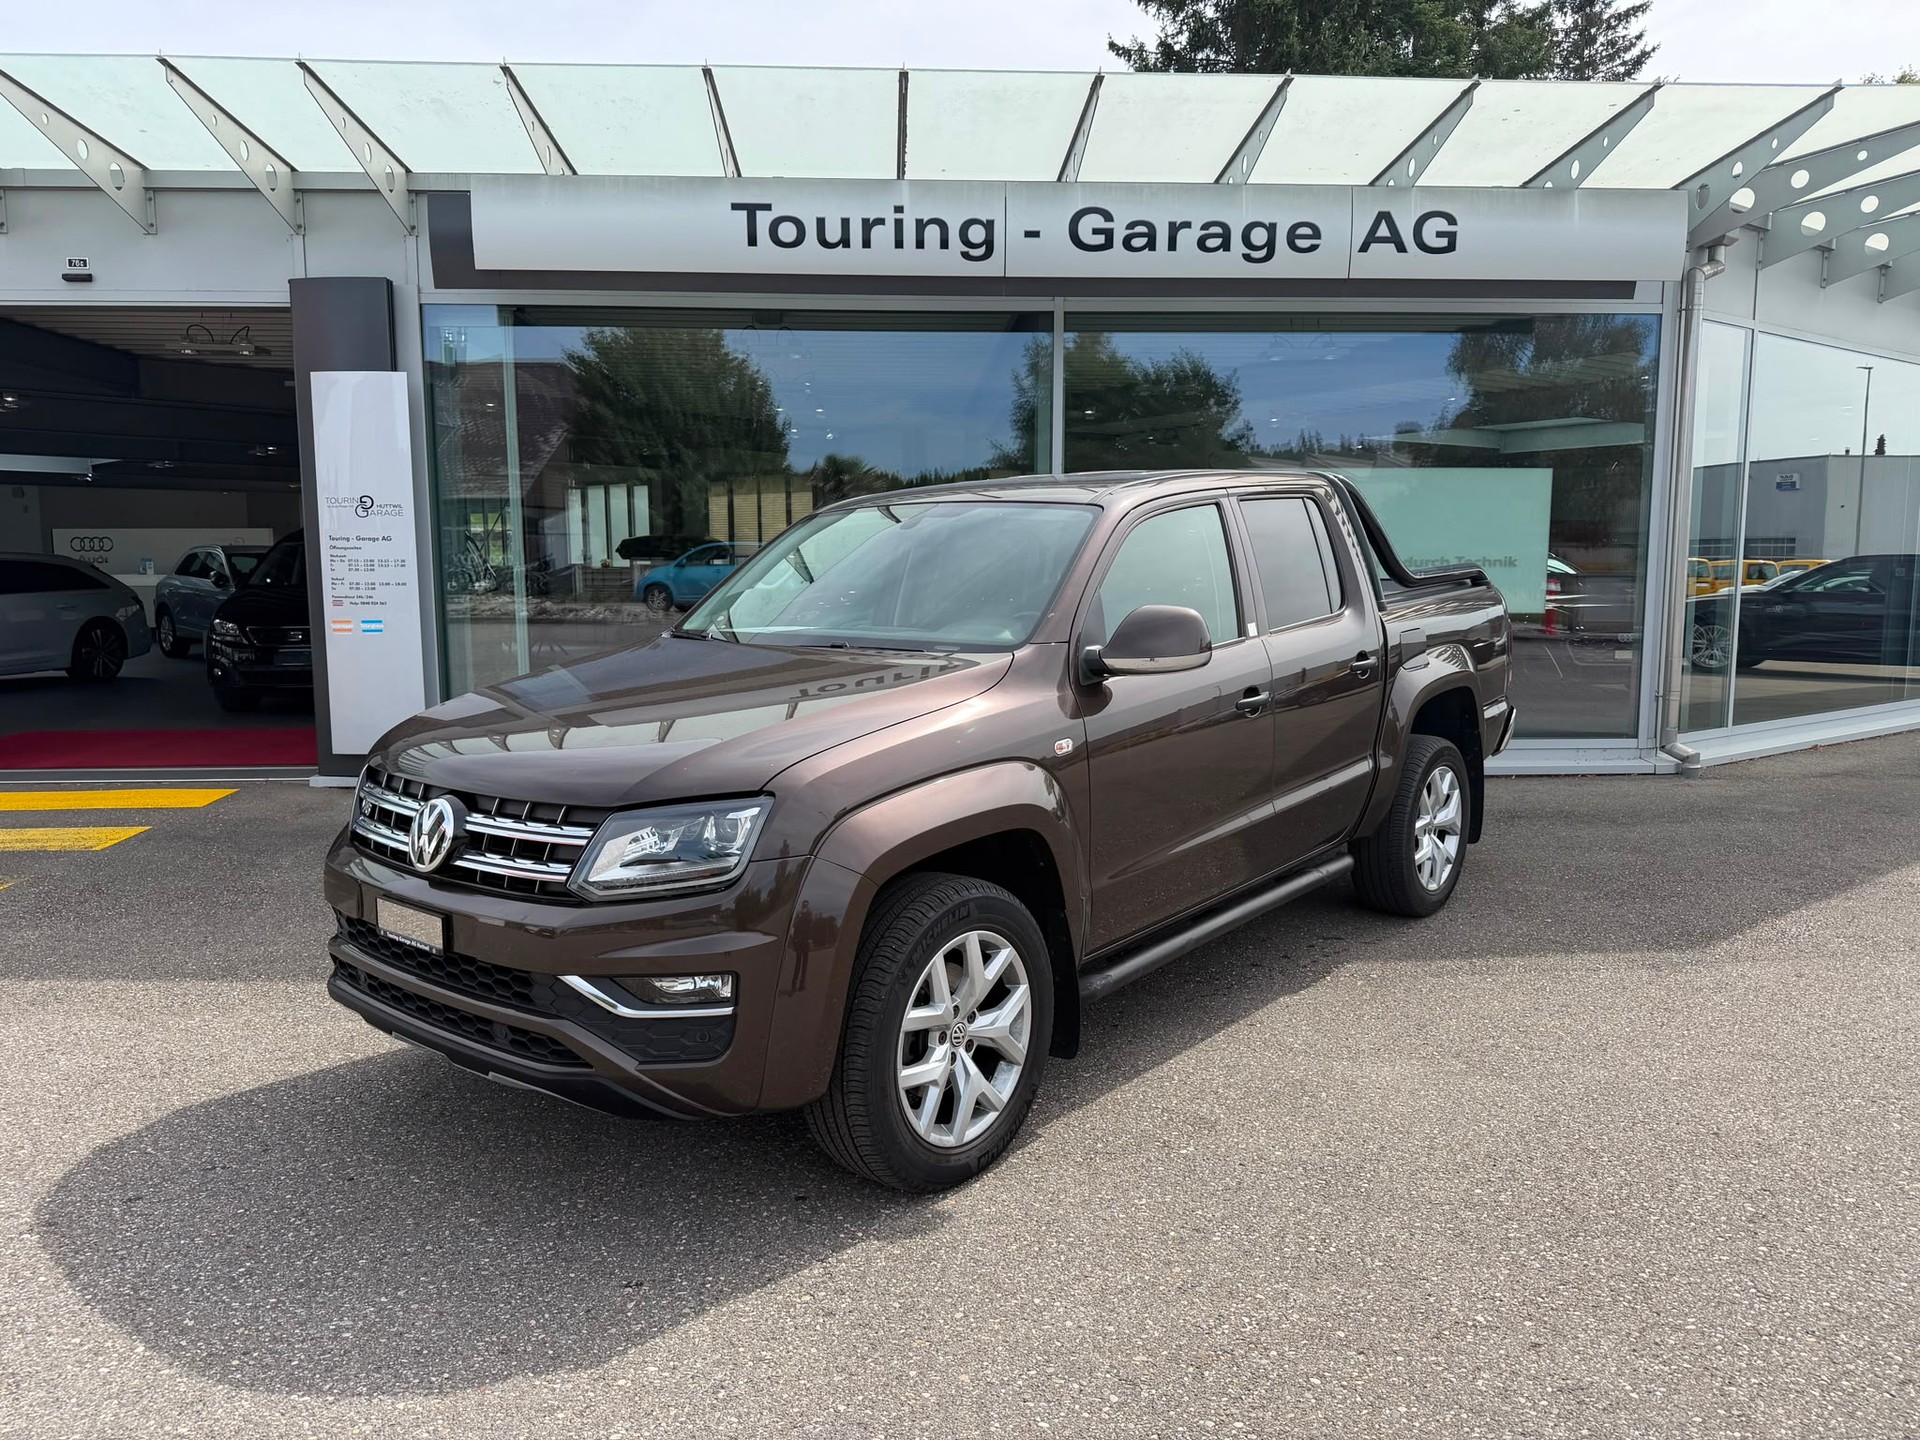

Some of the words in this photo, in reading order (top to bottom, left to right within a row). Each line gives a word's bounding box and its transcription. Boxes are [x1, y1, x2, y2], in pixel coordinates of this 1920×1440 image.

[730, 202, 996, 263] Touring
[1023, 230, 1041, 239] -
[1067, 206, 1323, 264] Garage
[1356, 210, 1460, 255] AG
[355, 535, 380, 543] Garage
[911, 904, 971, 968] MICHELIN
